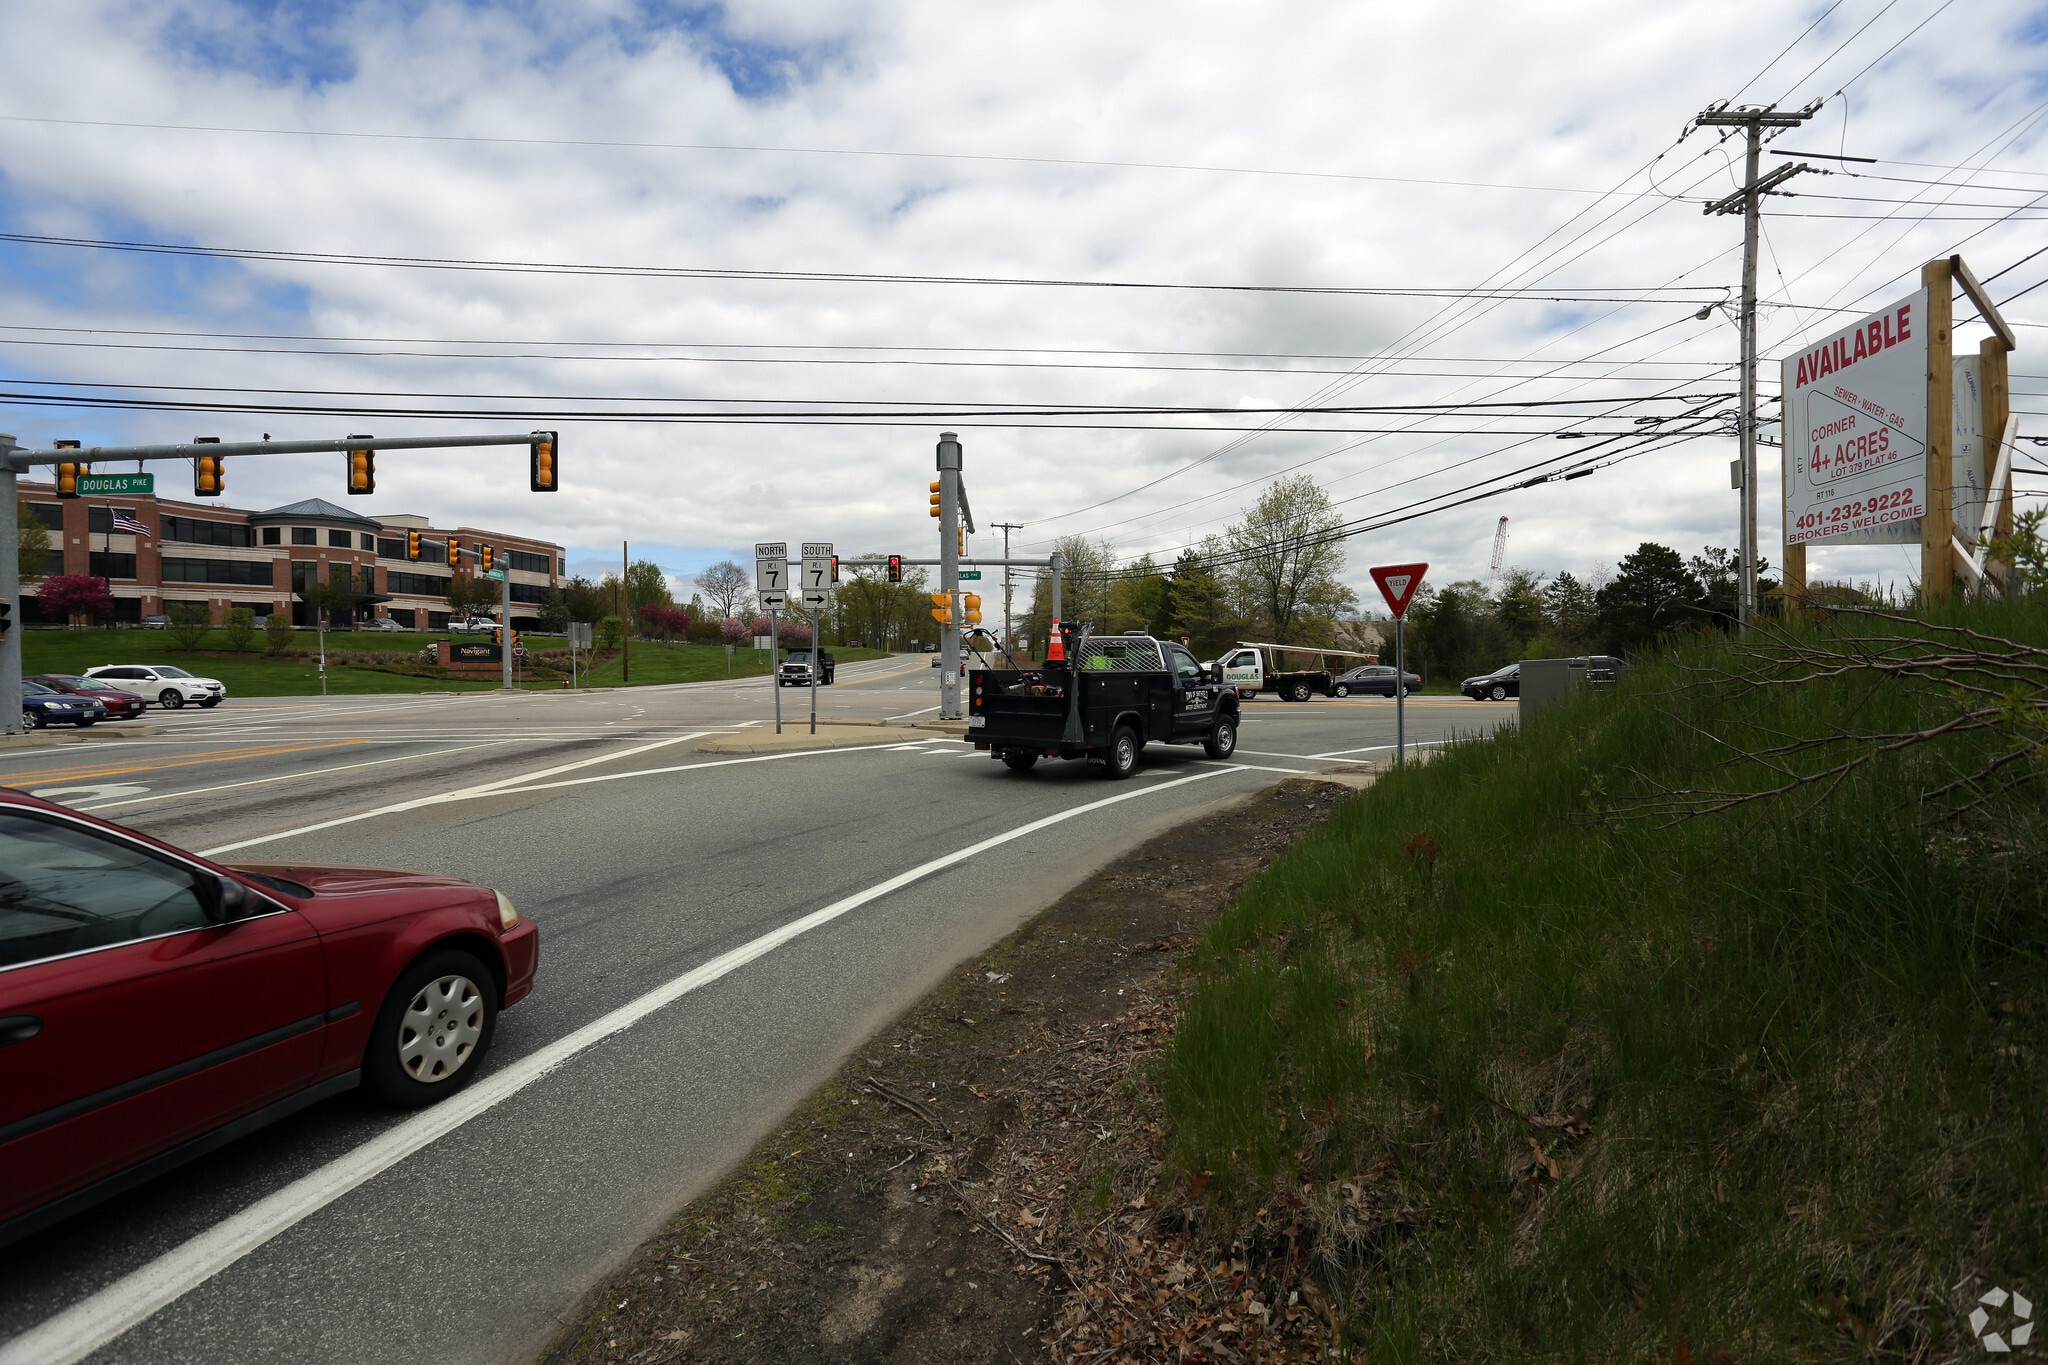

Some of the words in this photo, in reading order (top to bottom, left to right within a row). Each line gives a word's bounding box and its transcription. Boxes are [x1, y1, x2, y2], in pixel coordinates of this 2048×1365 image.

[1796, 304, 1911, 389] AVAILABLE
[1833, 386, 1858, 405] SEWER
[1862, 399, 1885, 418] WATER
[1889, 413, 1905, 428] GAS
[1811, 415, 1856, 442] CORNER
[1811, 445, 1831, 473] 4+
[1835, 427, 1889, 467] ACRES
[1831, 467, 1847, 479] LOT
[1849, 461, 1863, 474] 379
[1864, 454, 1886, 469] PLAT
[1887, 450, 1898, 461] 46
[83, 480, 128, 490] DOUGLAS
[132, 478, 147, 486] PIKE
[1816, 491, 1824, 500] RT
[1825, 488, 1835, 498] 116
[1796, 488, 1913, 529] 401-232-9222
[1789, 523, 1849, 543] BROKERS
[1852, 505, 1923, 530] WELCOME
[758, 546, 784, 556] NORTH
[803, 546, 831, 556] SOUTH
[766, 571, 779, 588] 7
[810, 570, 823, 587] 7
[1390, 579, 1407, 587] YIELD
[460, 648, 490, 656] Navigant
